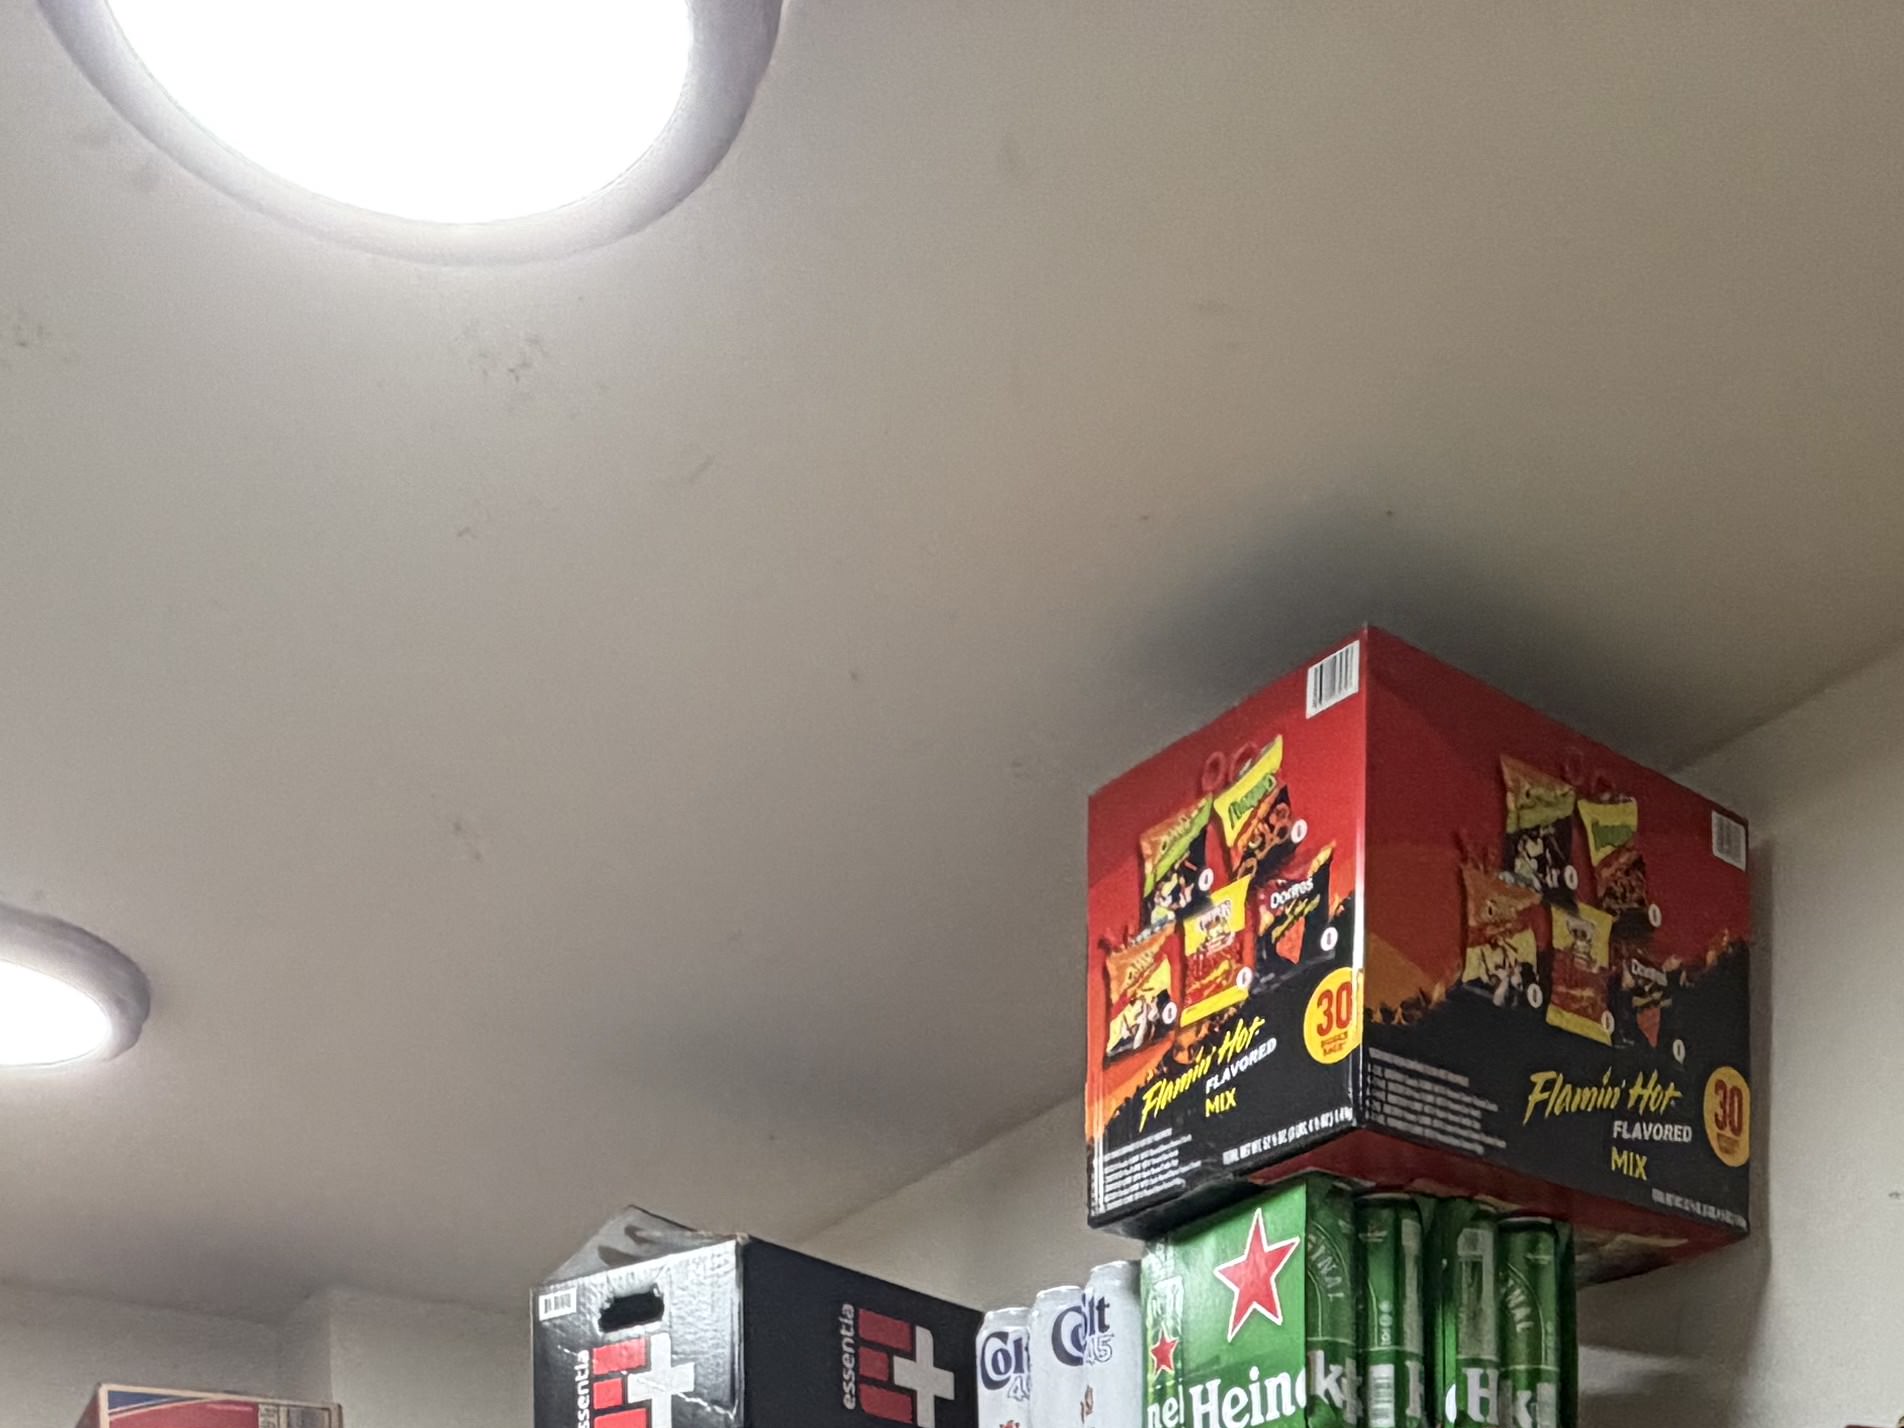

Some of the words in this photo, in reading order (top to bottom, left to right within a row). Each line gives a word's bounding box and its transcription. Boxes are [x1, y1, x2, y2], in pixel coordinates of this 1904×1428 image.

[1271, 878, 1313, 909] Doritos
[1316, 982, 1353, 1037] 30
[1205, 1038, 1277, 1094] FLAVORED
[1205, 1088, 1236, 1117] MIX
[1714, 1079, 1743, 1136] 30
[1613, 1120, 1692, 1143] FLAVORED
[1611, 1146, 1648, 1181] MIX
[841, 1303, 855, 1409] essentia
